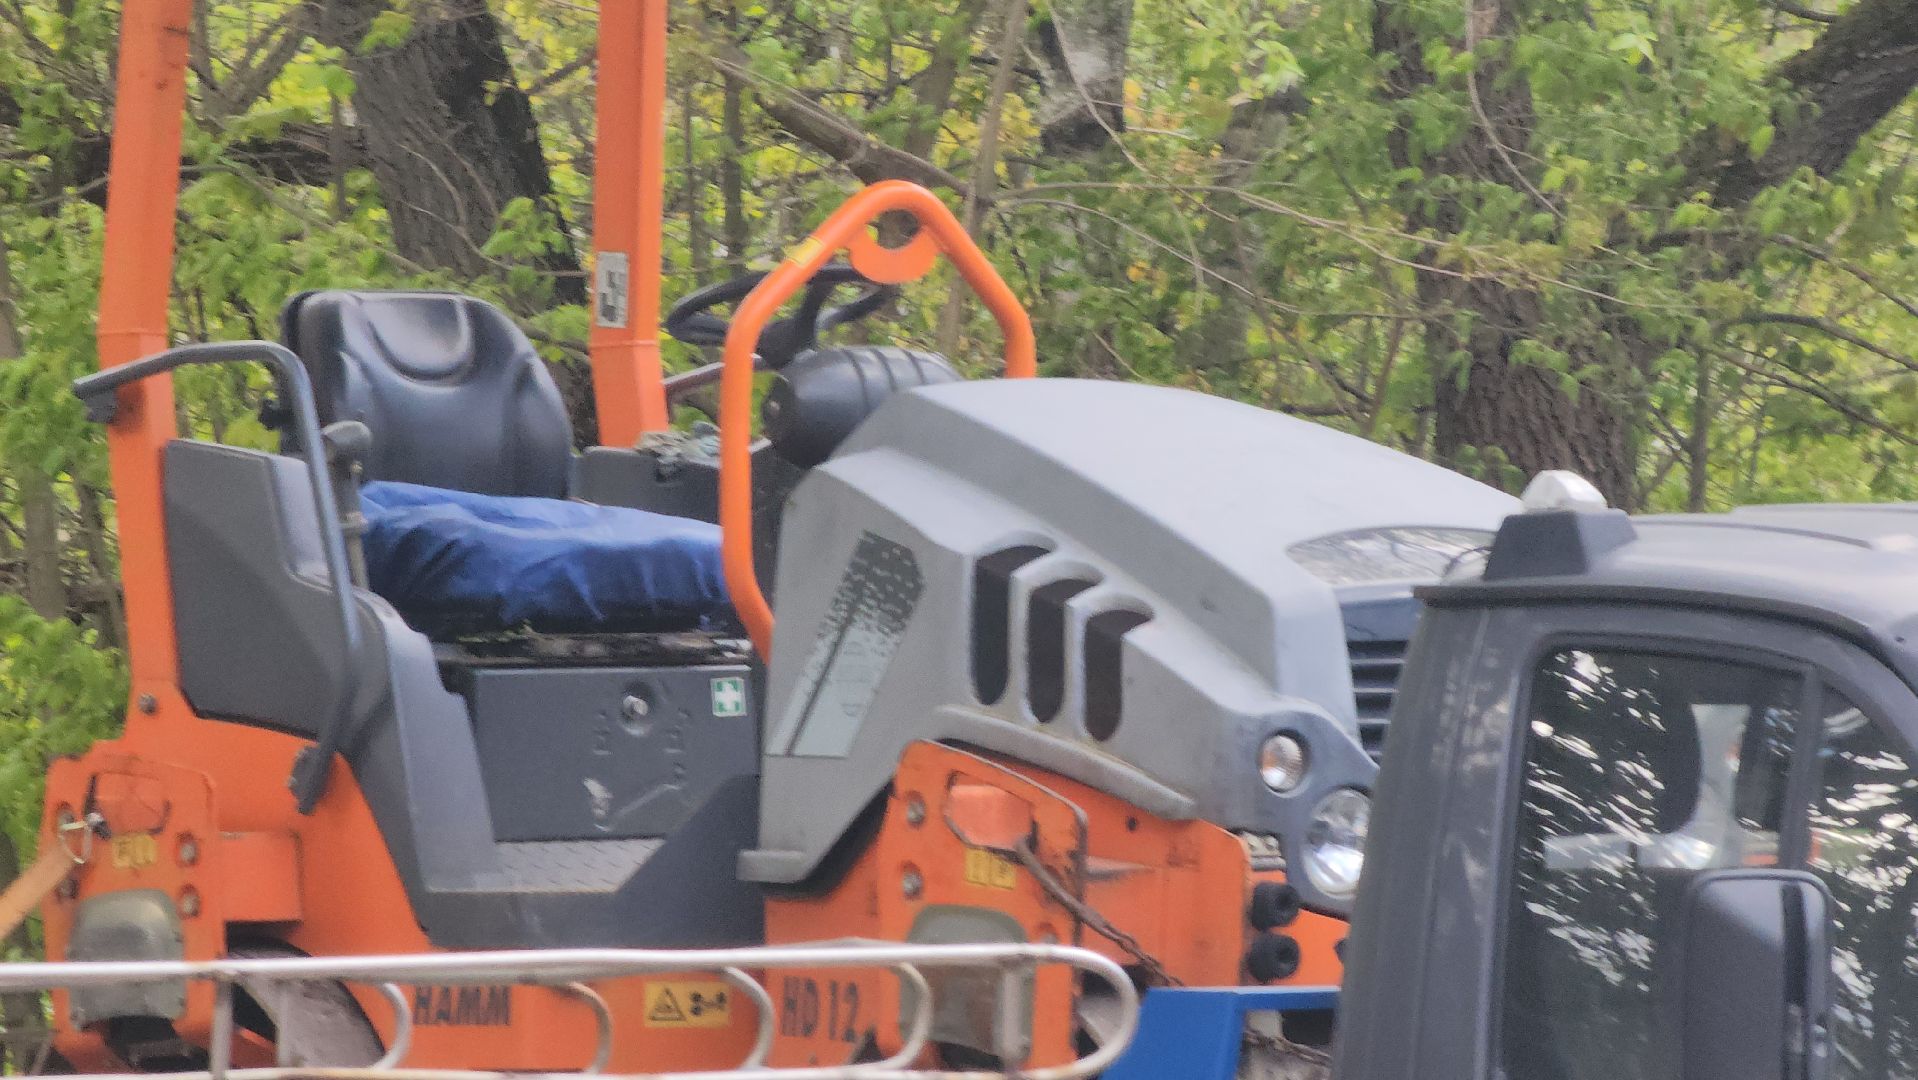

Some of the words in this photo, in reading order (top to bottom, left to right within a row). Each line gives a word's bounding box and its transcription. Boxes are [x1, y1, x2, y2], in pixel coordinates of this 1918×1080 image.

[414, 986, 511, 1026] HAMM
[781, 977, 820, 1037] HD
[829, 979, 860, 1042] 12
